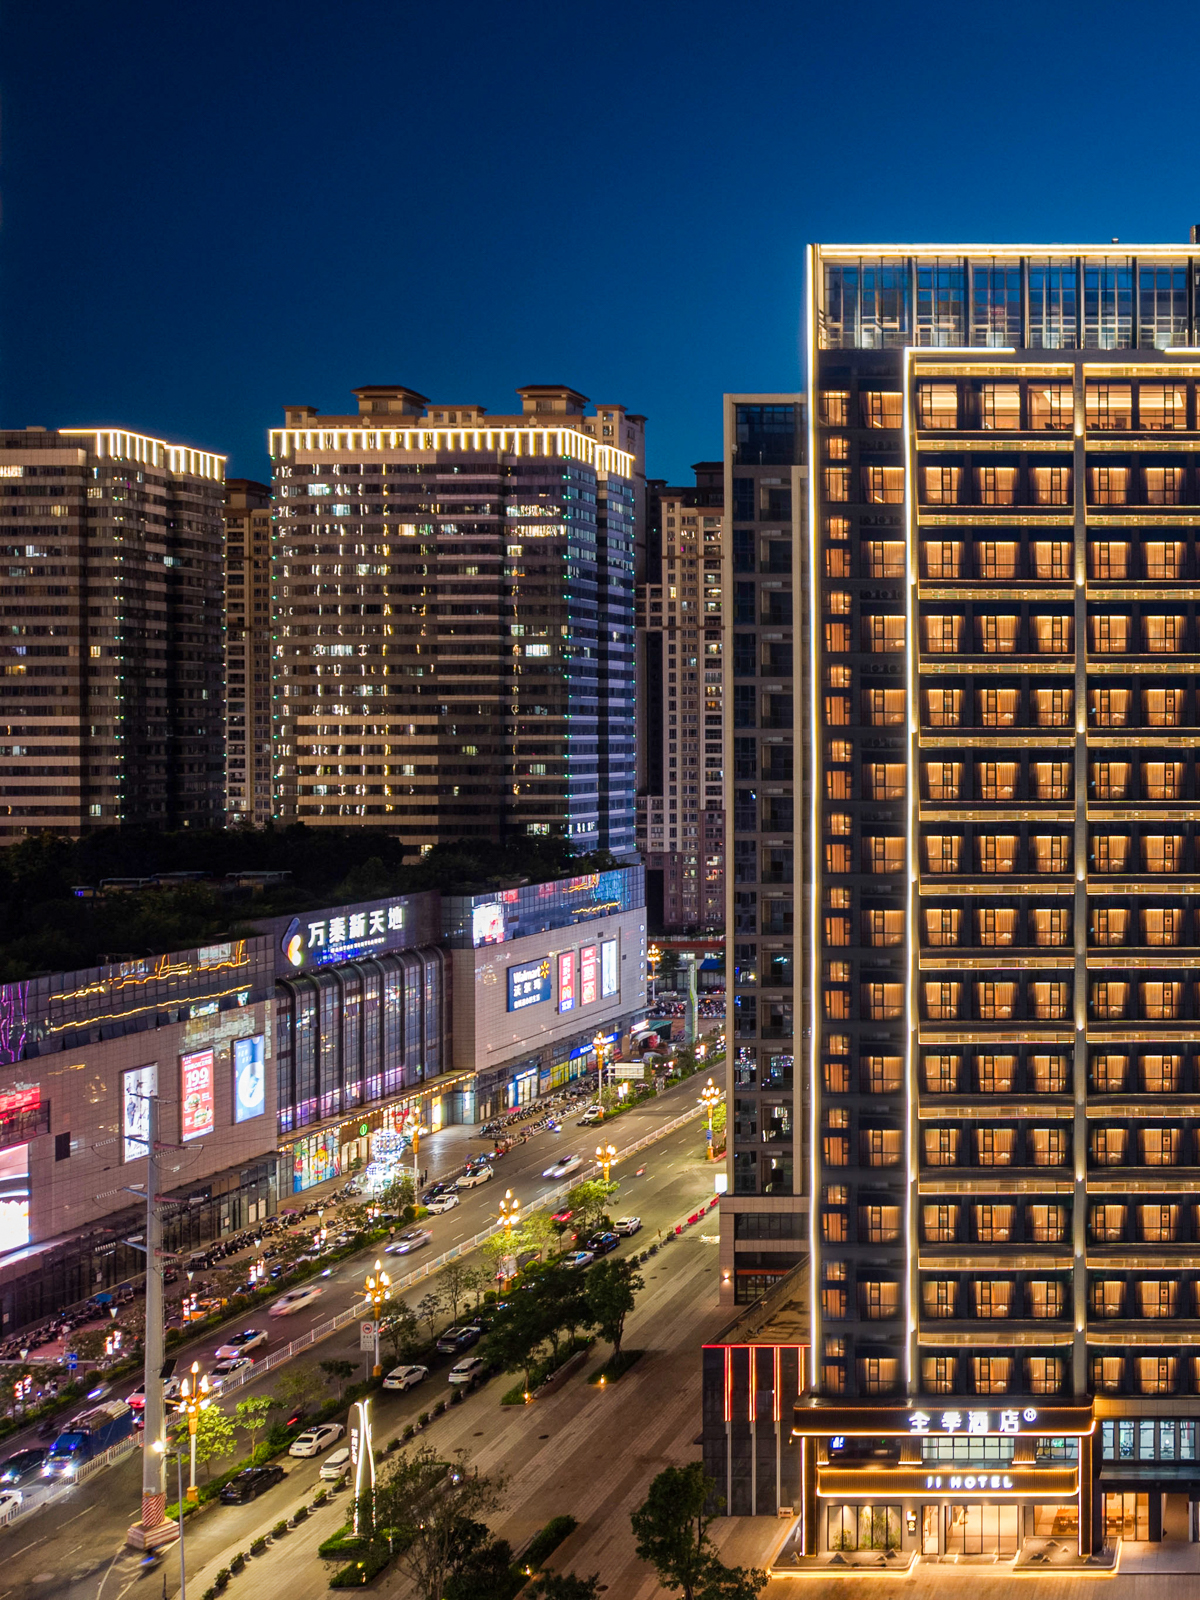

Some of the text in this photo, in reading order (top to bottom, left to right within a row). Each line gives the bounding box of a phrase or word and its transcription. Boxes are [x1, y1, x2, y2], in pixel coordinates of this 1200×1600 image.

[308, 906, 403, 948] 万泰新天地
[513, 966, 541, 984] Walmart
[513, 978, 542, 997] 沃尔玛
[908, 1410, 1020, 1433] 全季酒店
[950, 1475, 1013, 1489] HOTEL
